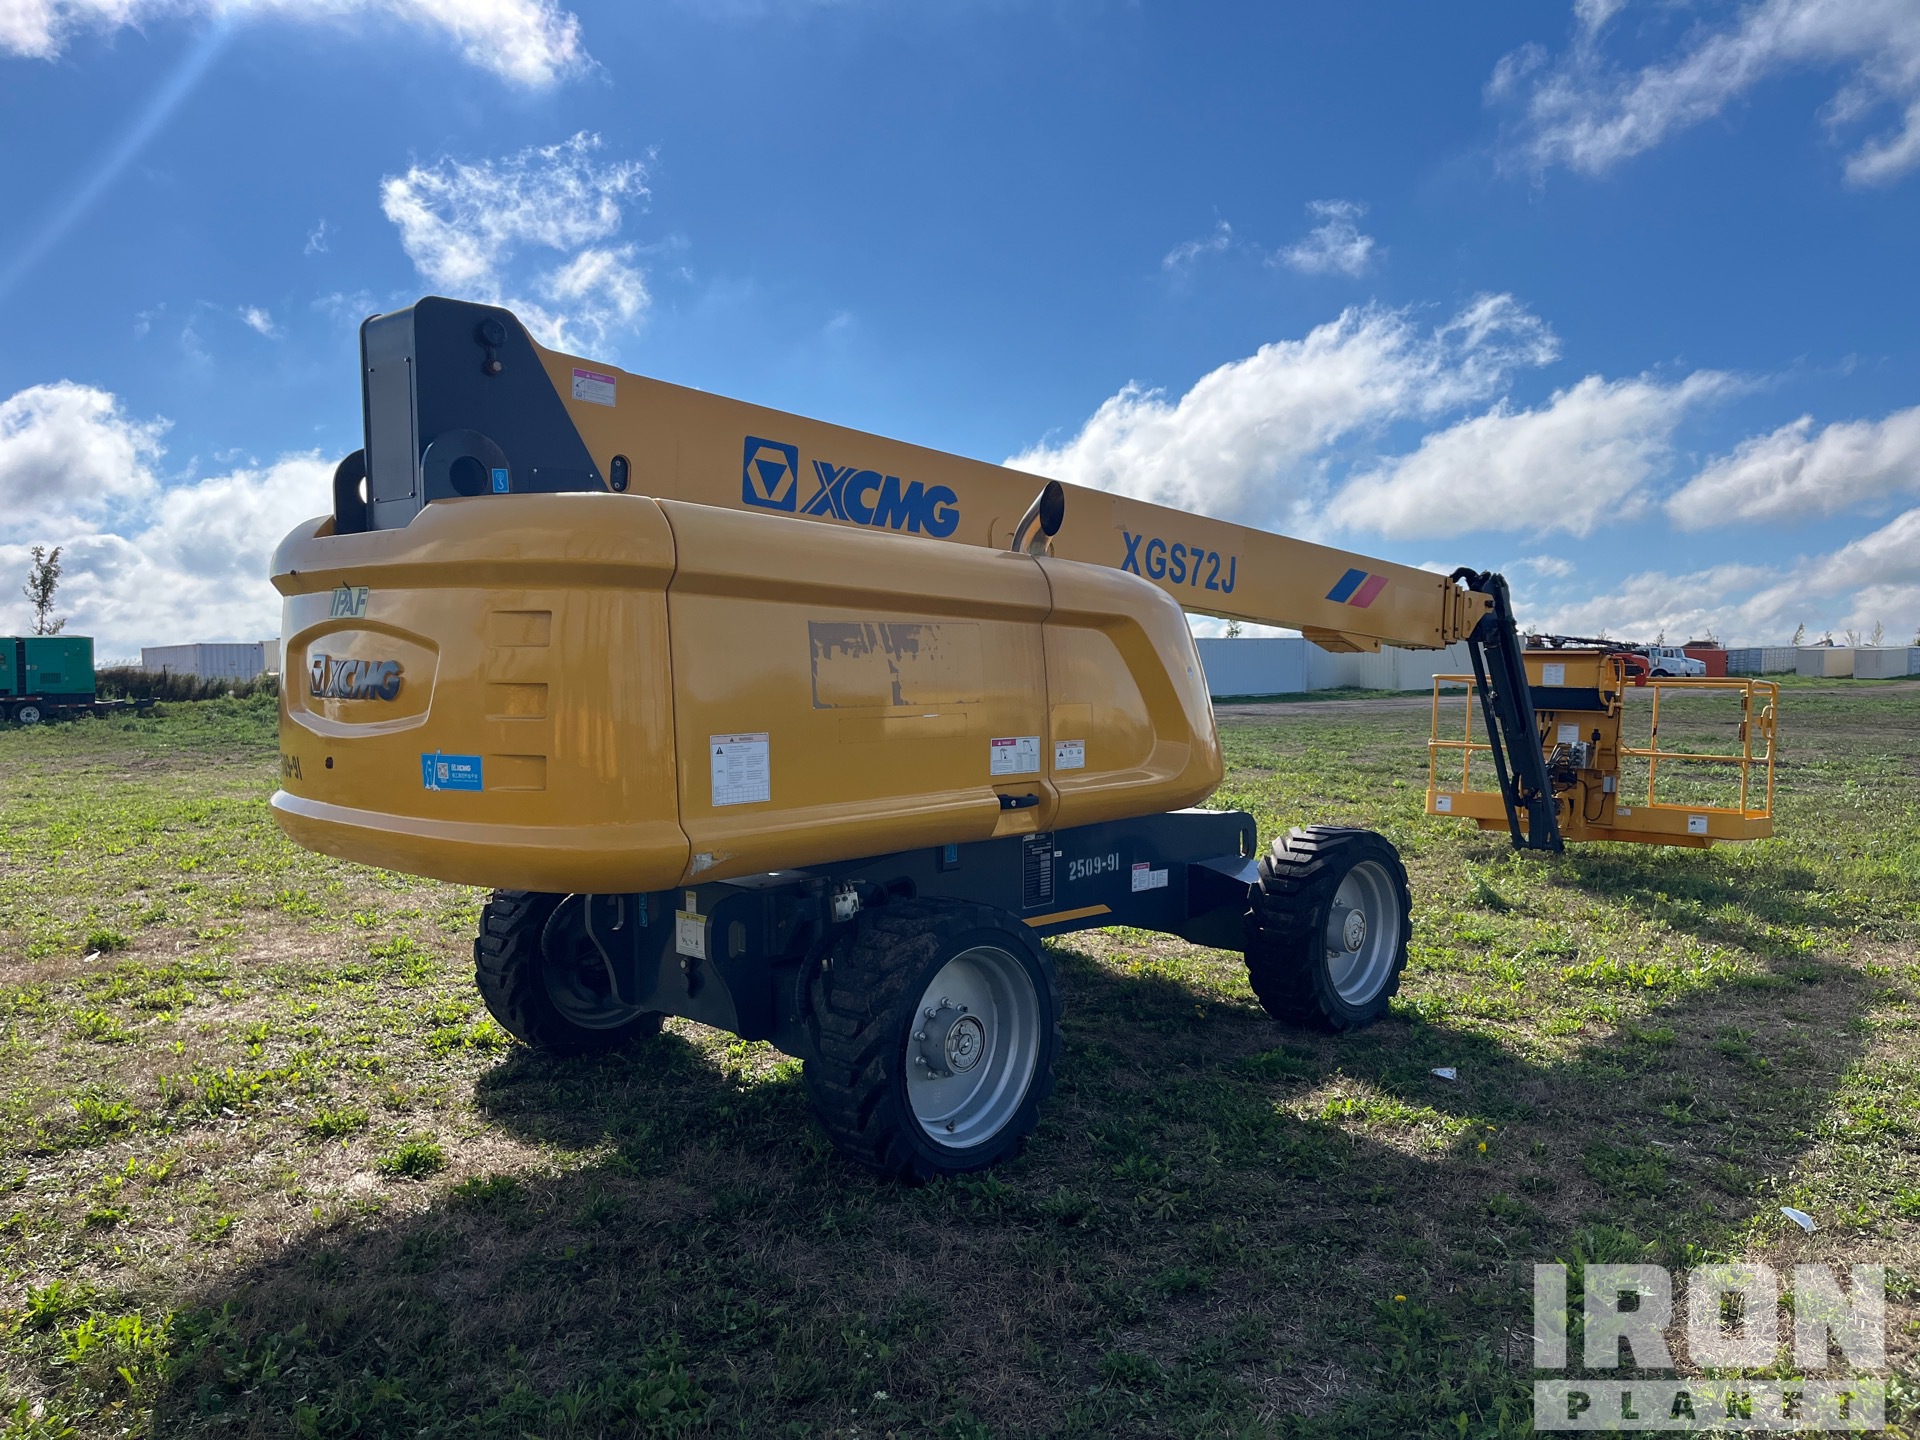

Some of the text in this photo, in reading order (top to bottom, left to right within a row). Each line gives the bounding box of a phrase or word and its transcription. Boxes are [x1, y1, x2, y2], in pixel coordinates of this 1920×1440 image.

[800, 460, 960, 538] XCMG
[1120, 531, 1236, 593] XGS72J
[329, 588, 368, 616] IPAF
[324, 660, 401, 701] XCMG
[1069, 853, 1119, 880] 2509-91
